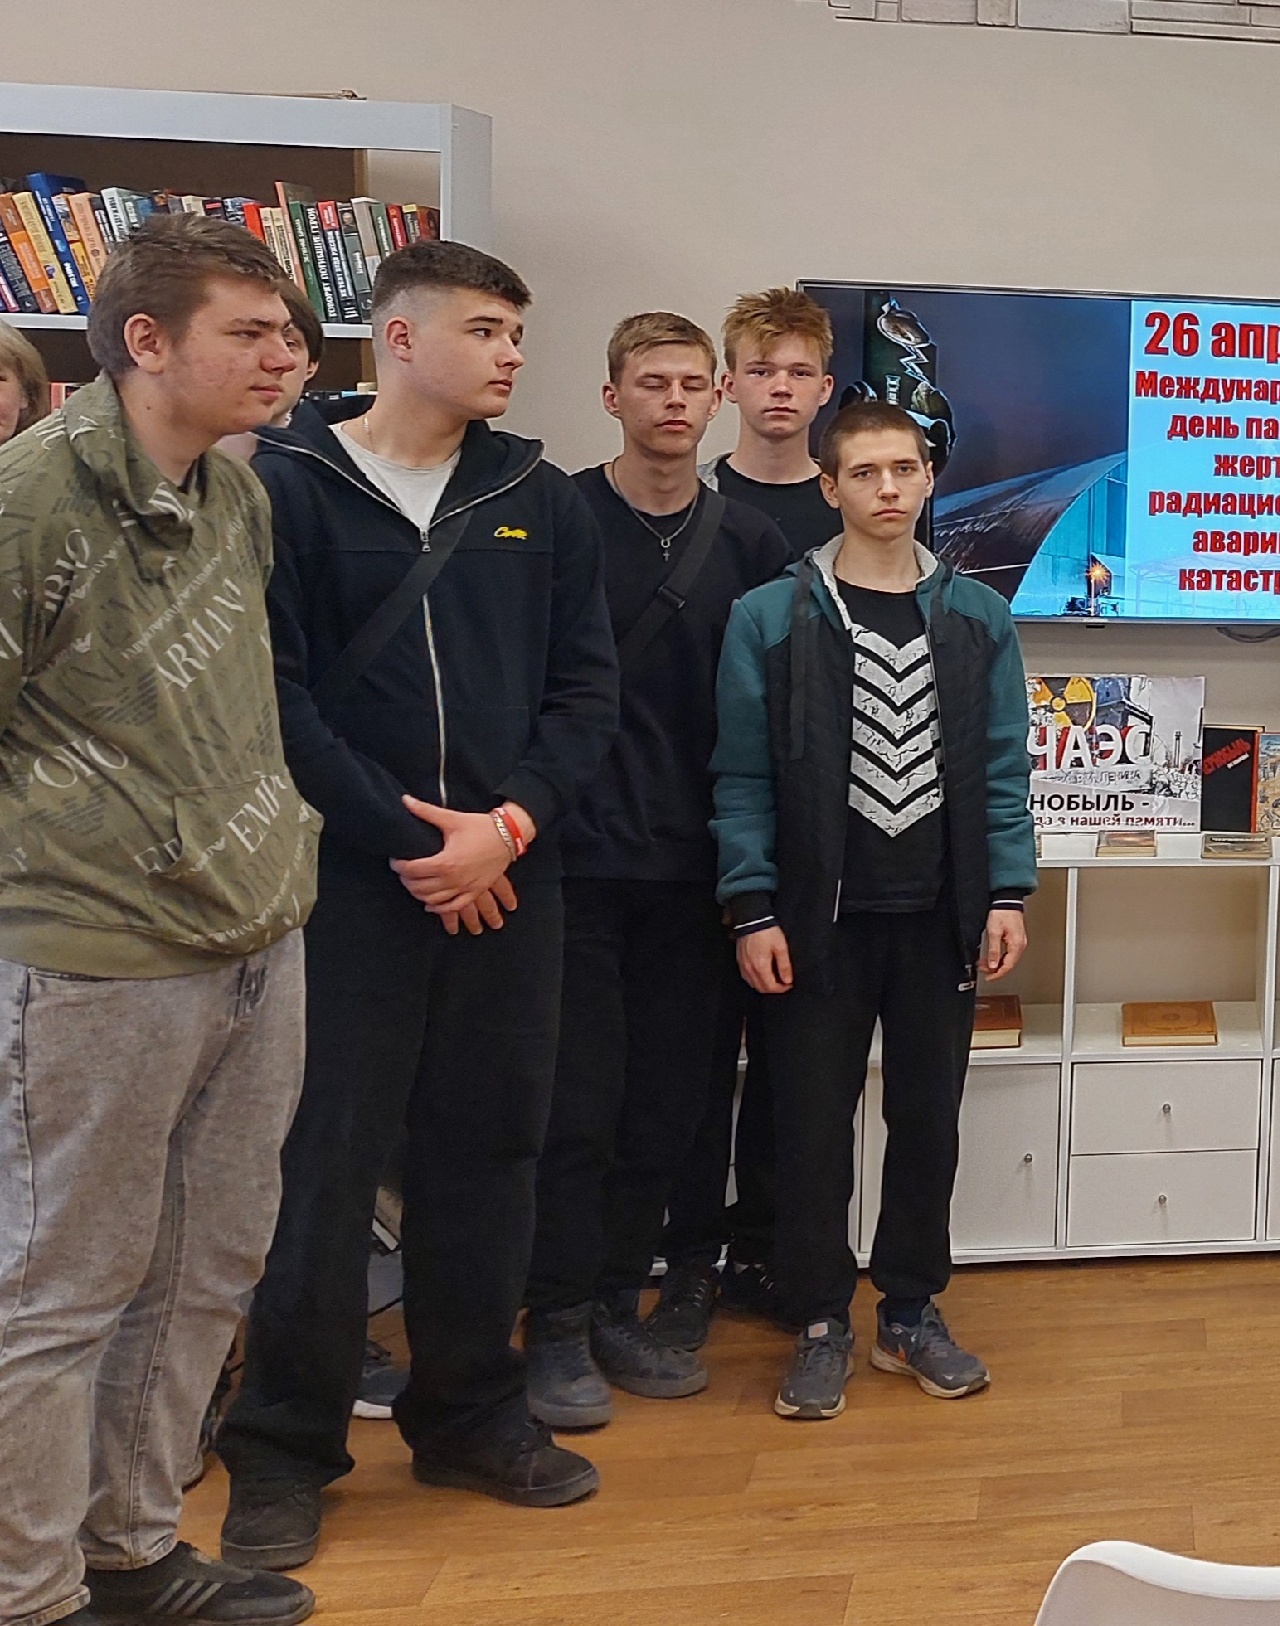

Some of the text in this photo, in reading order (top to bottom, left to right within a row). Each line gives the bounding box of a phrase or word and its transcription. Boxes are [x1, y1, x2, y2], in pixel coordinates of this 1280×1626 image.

[307, 207, 338, 318] ГОВОРЯТ ПОГИБШИЕ ГЕРОИ
[1144, 312, 1200, 357] 26
[1168, 414, 1239, 441] день
[1027, 724, 1152, 773] ЧАЭС
[1070, 814, 1121, 826] нашей
